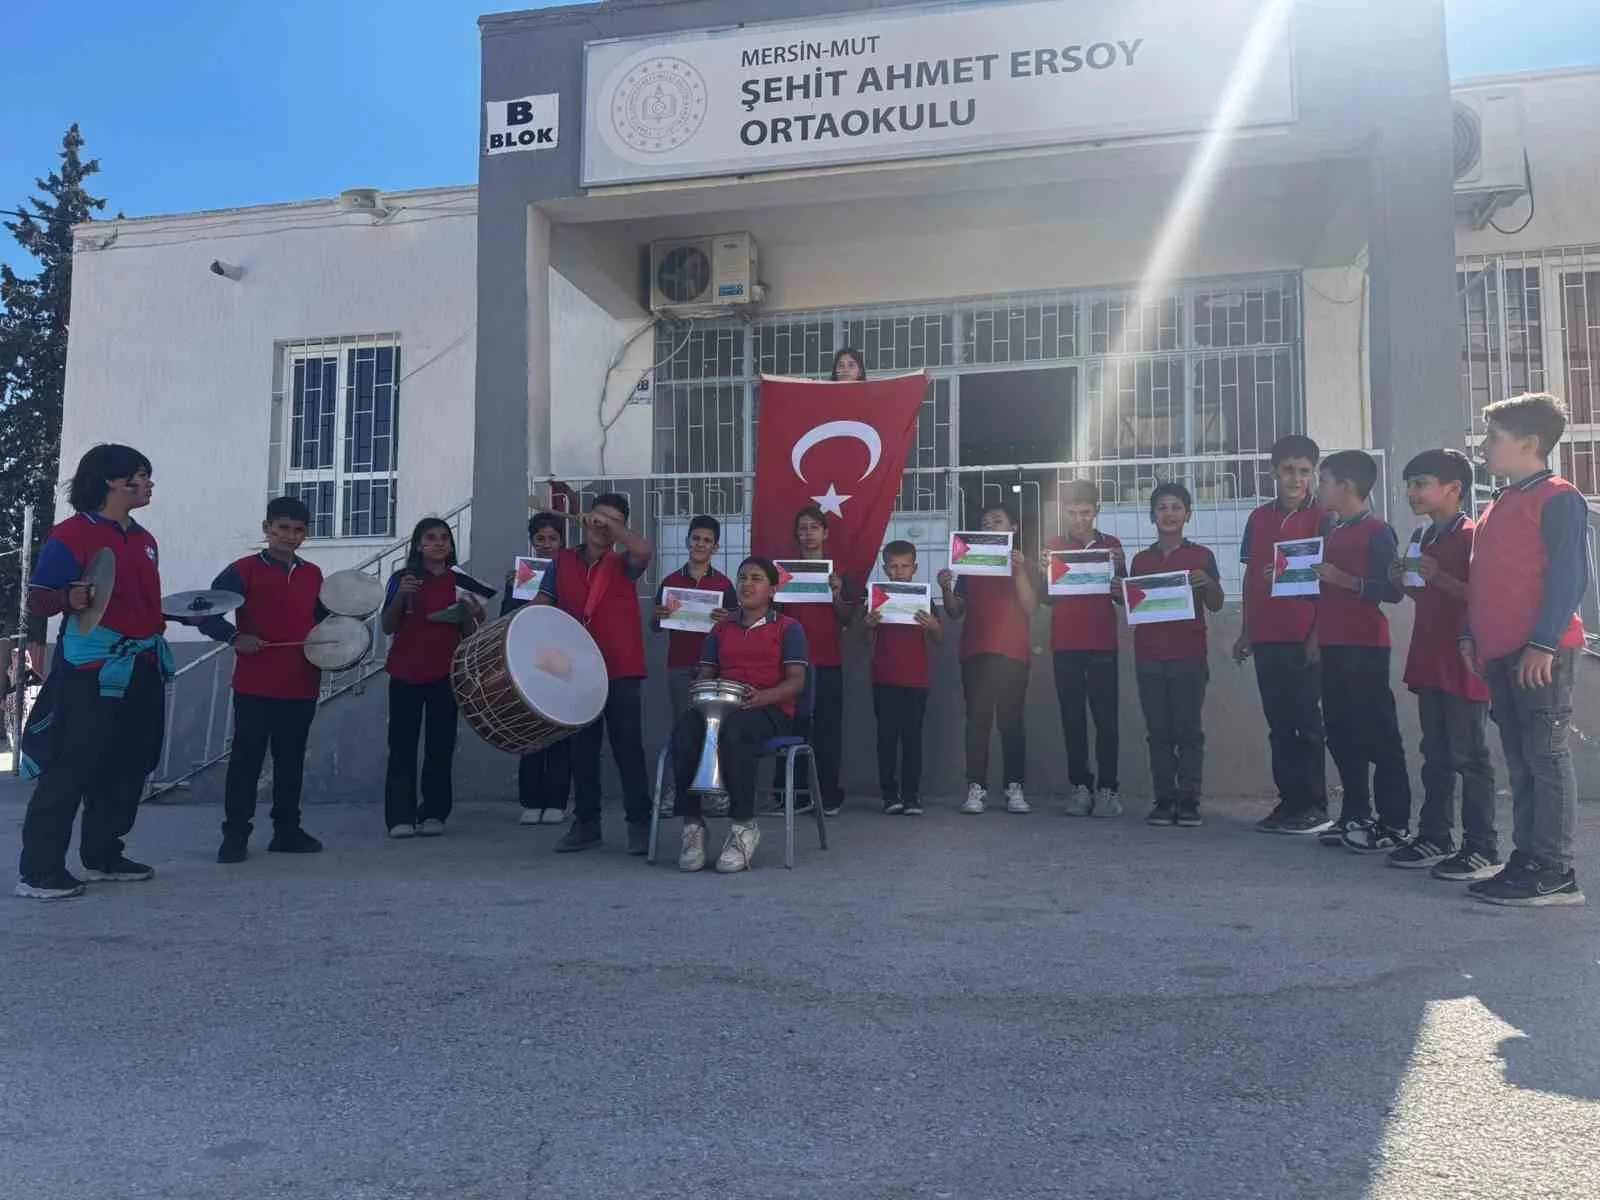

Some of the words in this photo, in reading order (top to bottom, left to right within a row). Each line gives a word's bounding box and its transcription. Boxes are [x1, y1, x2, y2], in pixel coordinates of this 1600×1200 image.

[741, 35, 880, 67] MERSİN-MUT
[741, 66, 848, 112] ŞEHİT
[857, 54, 999, 94] AHMET
[1010, 38, 1144, 78] ERSOY
[507, 101, 534, 126] B
[740, 98, 976, 146] ORTAOKULU
[490, 127, 553, 149] BLOK
